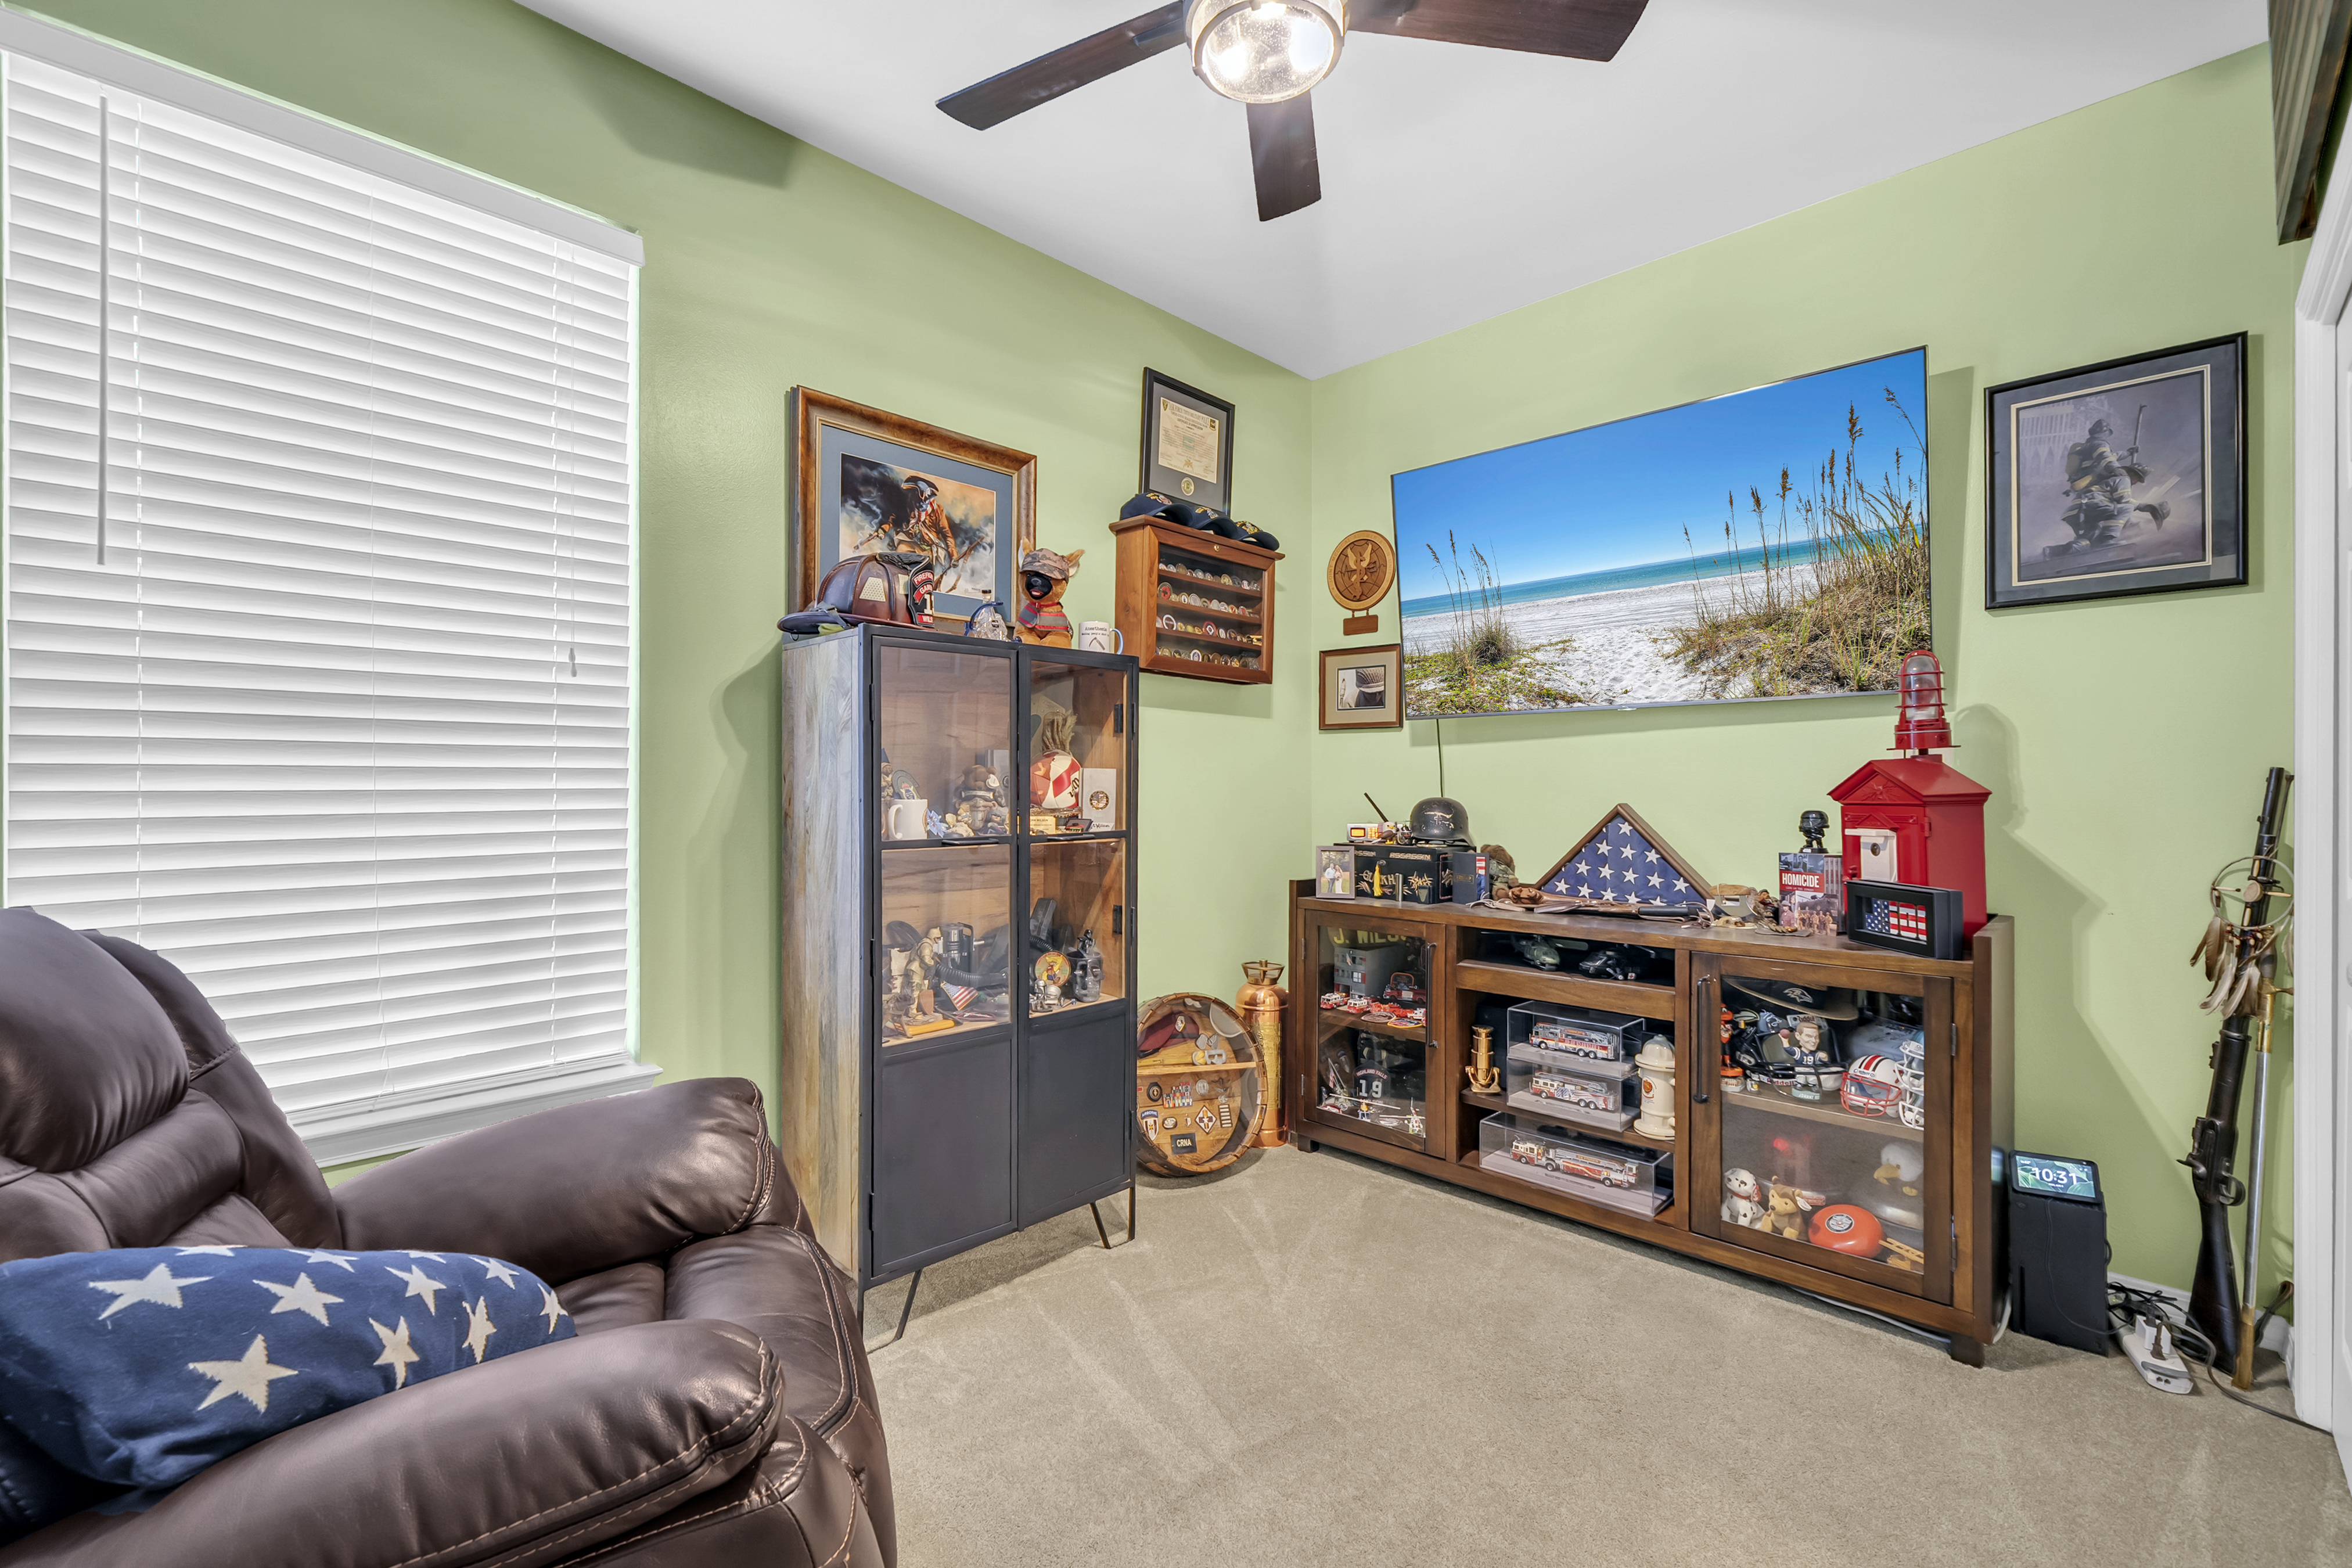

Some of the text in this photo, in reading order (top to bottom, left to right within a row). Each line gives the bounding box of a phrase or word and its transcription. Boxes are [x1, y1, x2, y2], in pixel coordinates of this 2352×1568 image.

[1389, 852, 1432, 861] ASSASSIN
[1362, 870, 1396, 885] GUKH
[1782, 873, 1819, 887] HOMICIDE
[1802, 1056, 1814, 1064] 19
[1356, 1069, 1387, 1080] HIGHLAND FALLS
[1359, 1079, 1382, 1098] 19
[1177, 1138, 1192, 1147] CRNA
[2031, 1167, 2077, 1185] 10:31
